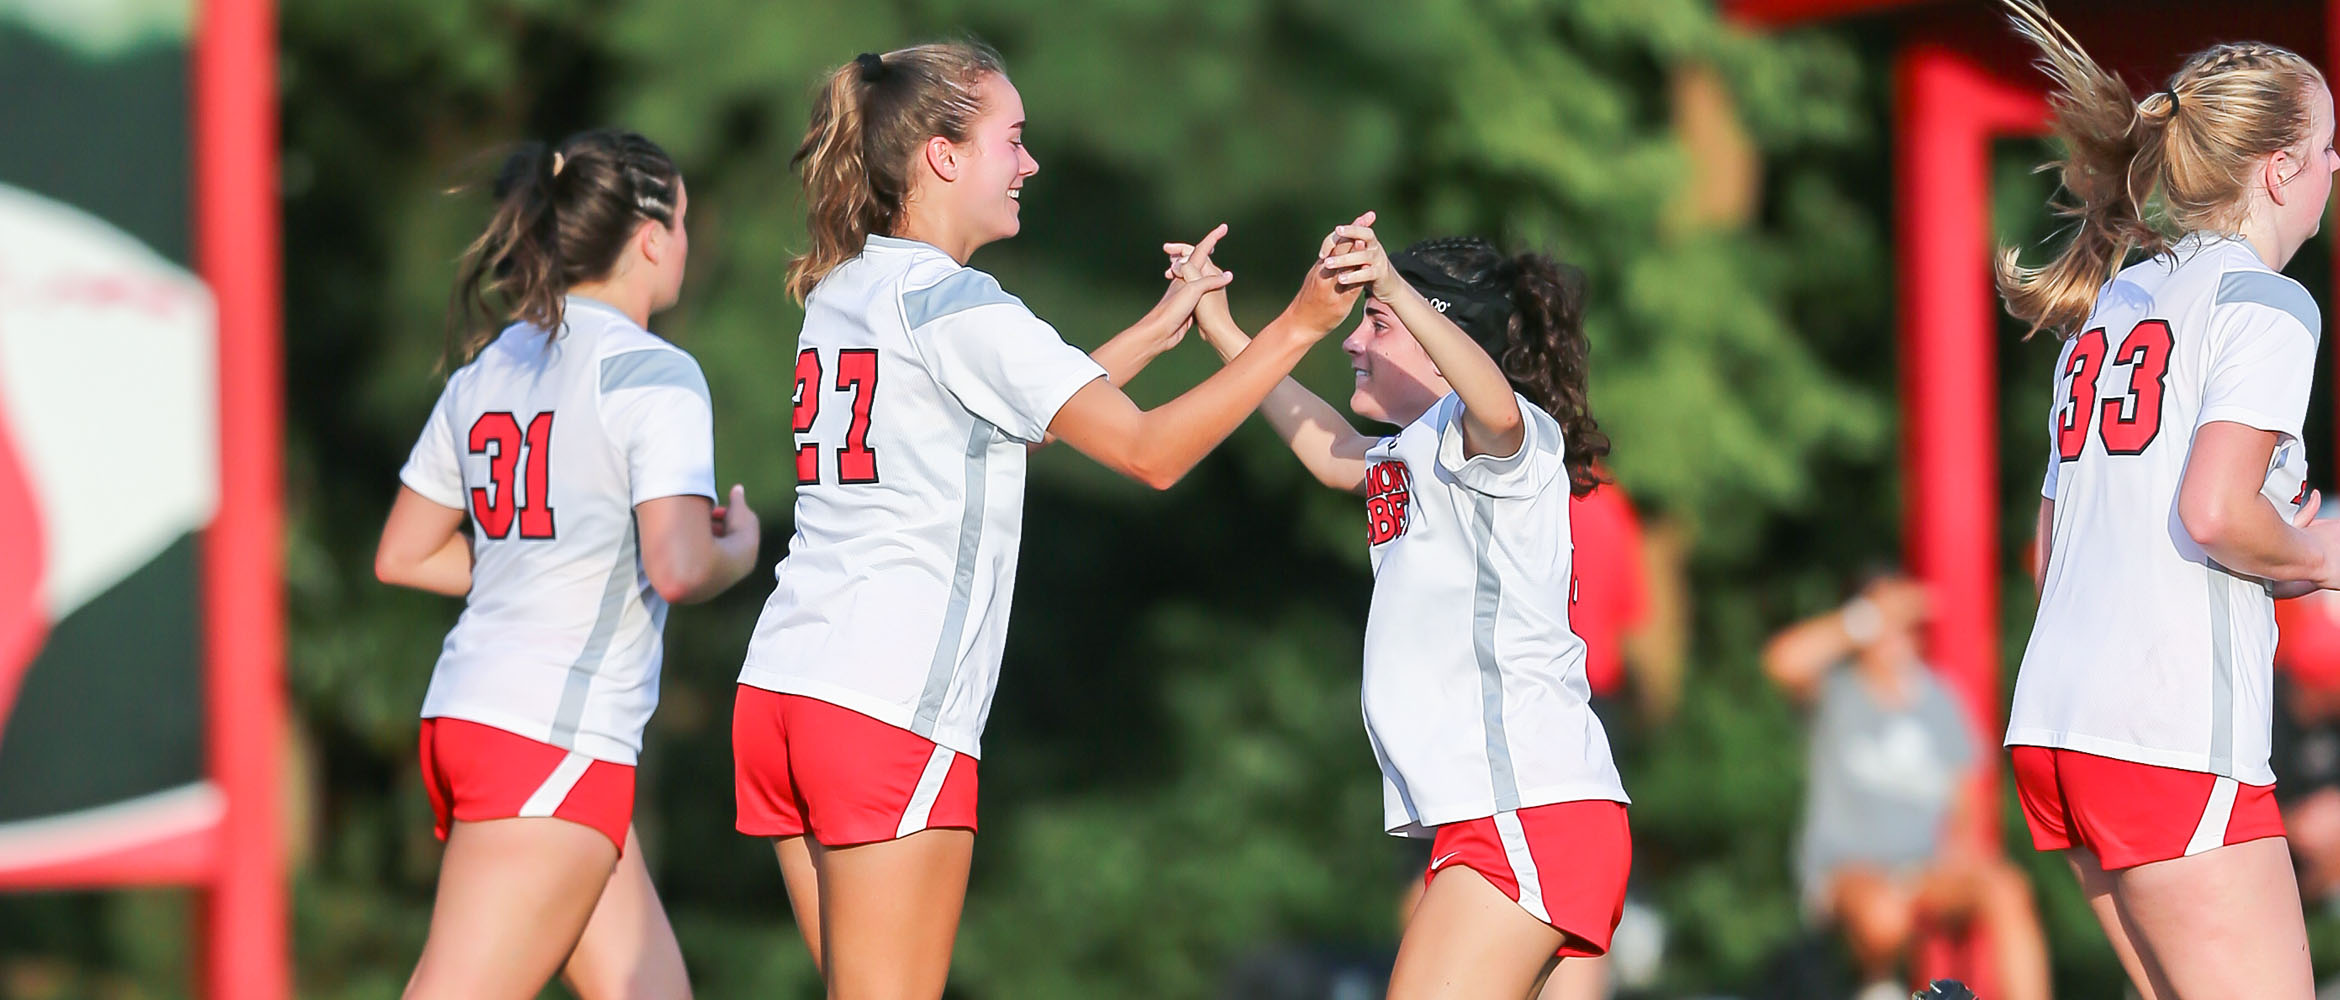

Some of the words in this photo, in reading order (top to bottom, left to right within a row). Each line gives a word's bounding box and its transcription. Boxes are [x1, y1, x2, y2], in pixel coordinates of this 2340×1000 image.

[792, 348, 879, 485] 27
[2058, 319, 2175, 463] 33
[469, 411, 556, 539] 31
